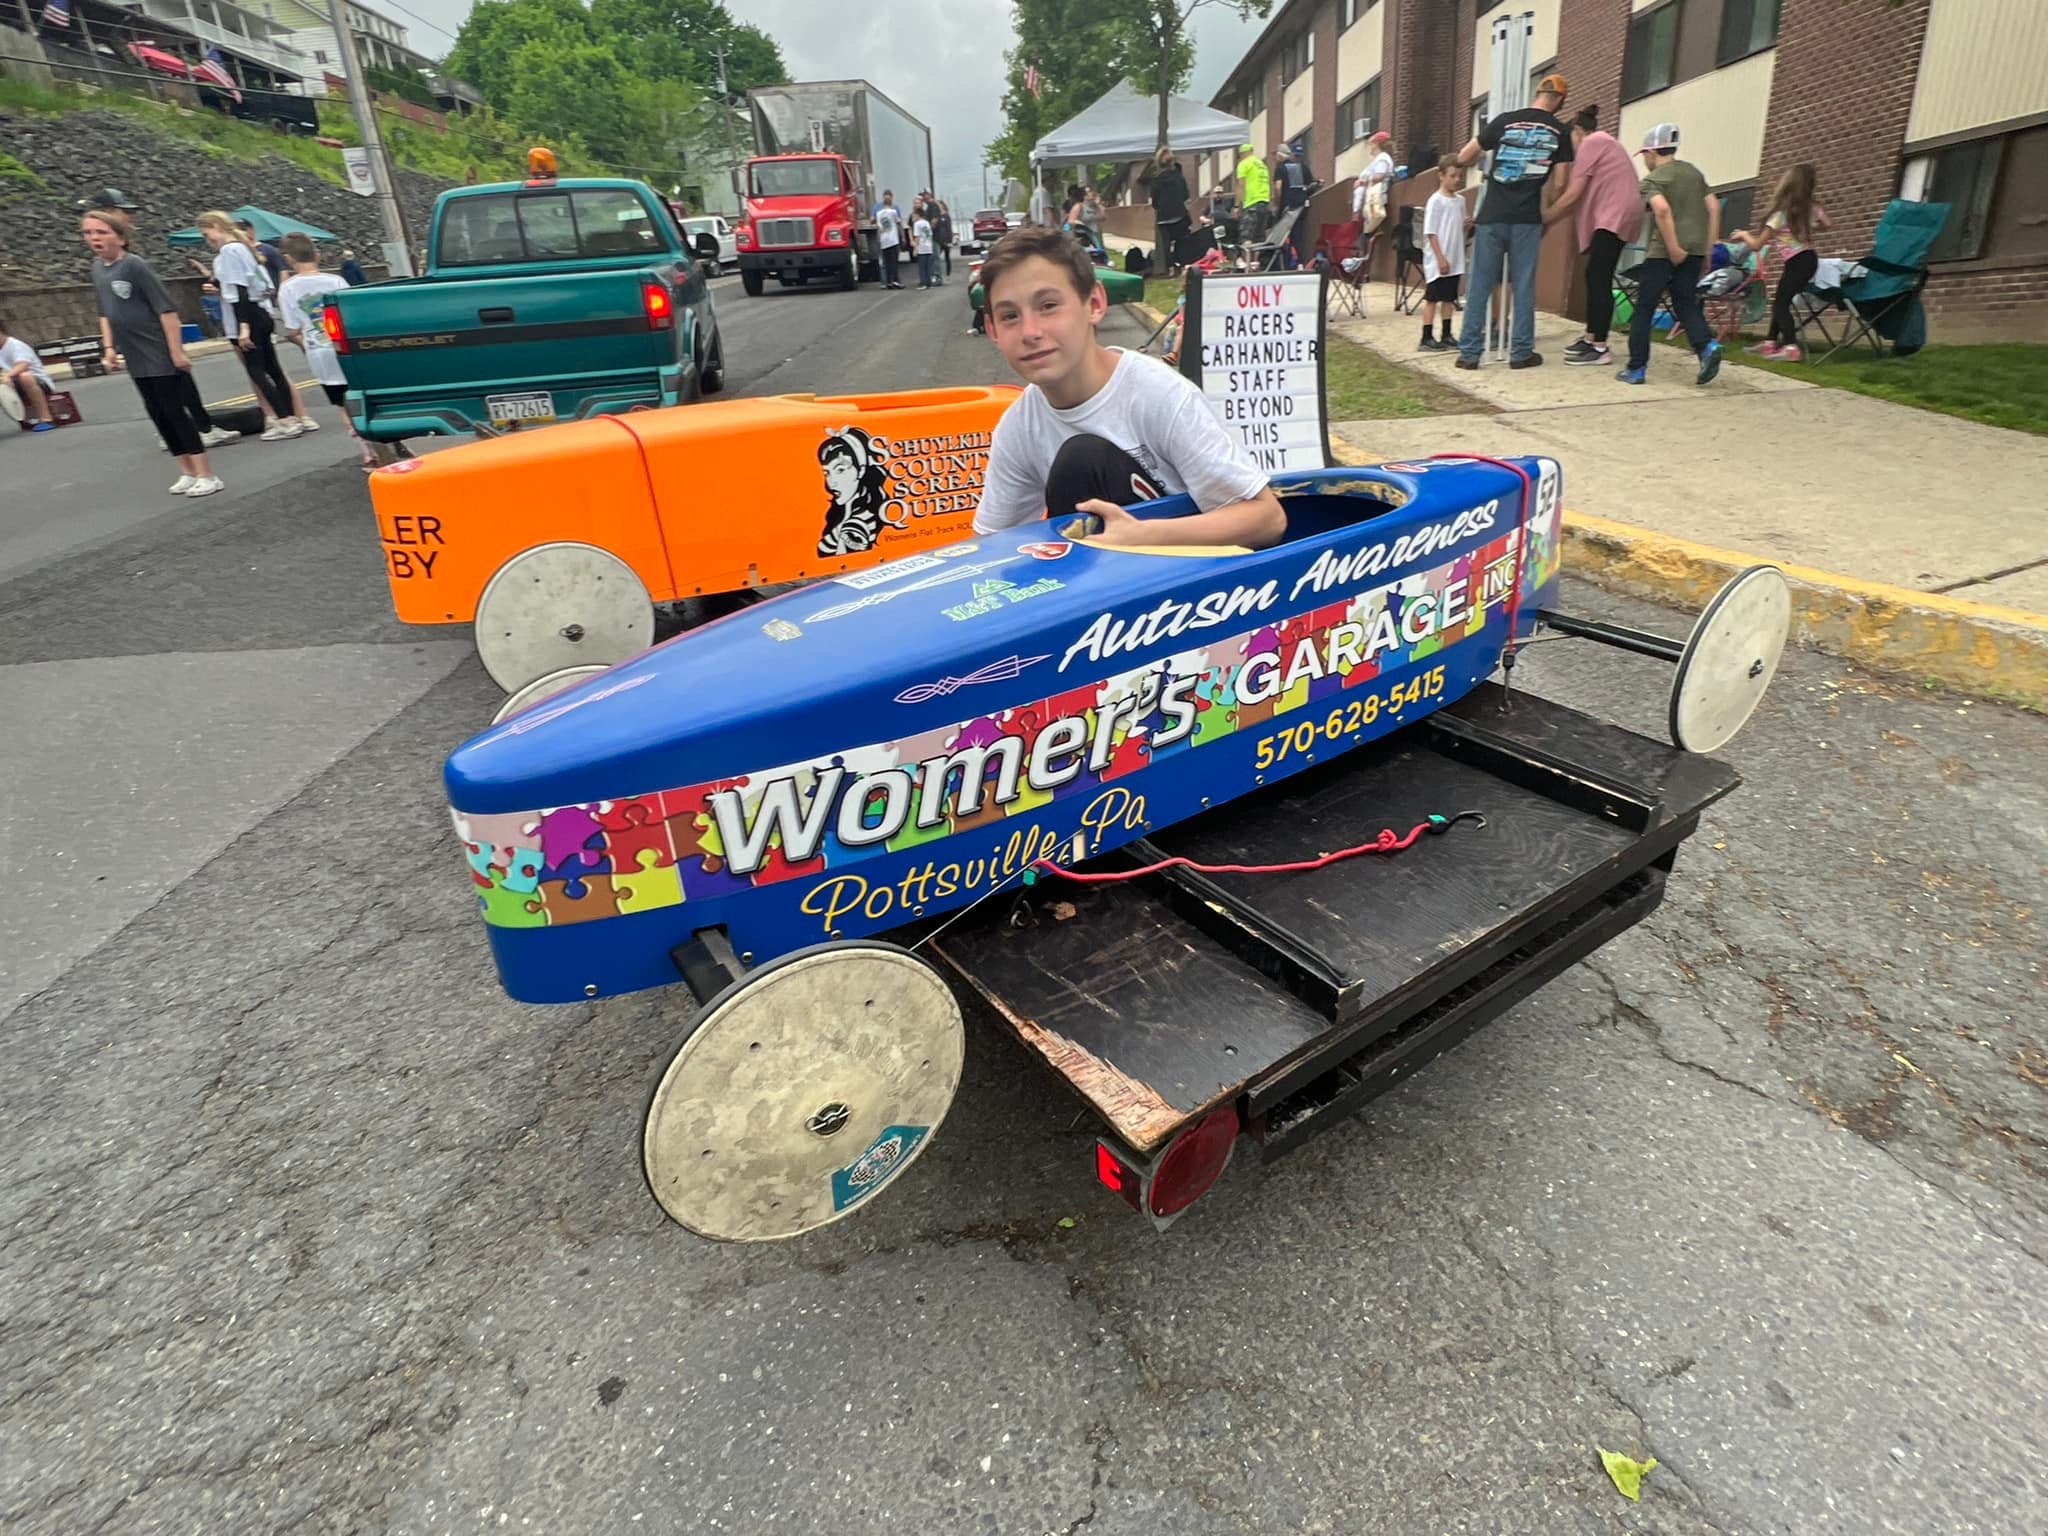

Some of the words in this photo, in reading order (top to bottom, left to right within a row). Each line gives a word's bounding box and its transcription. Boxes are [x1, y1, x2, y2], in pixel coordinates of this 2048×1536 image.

[1237, 284, 1283, 309] ONLY
[1225, 312, 1294, 338] RACERS
[358, 334, 457, 350] CHEVROLET
[1229, 369, 1285, 393] STAFF
[1225, 396, 1293, 420] BEYOND
[1240, 423, 1279, 446] THIS
[868, 431, 992, 467] SCHUYLKIL
[1250, 449, 1287, 470] INT
[878, 492, 982, 530] QUEEN
[1058, 579, 1280, 673] Autism
[1291, 499, 1498, 604] Awareness
[1255, 664, 1446, 770] 570-628-5415
[704, 672, 1202, 876] Womer's
